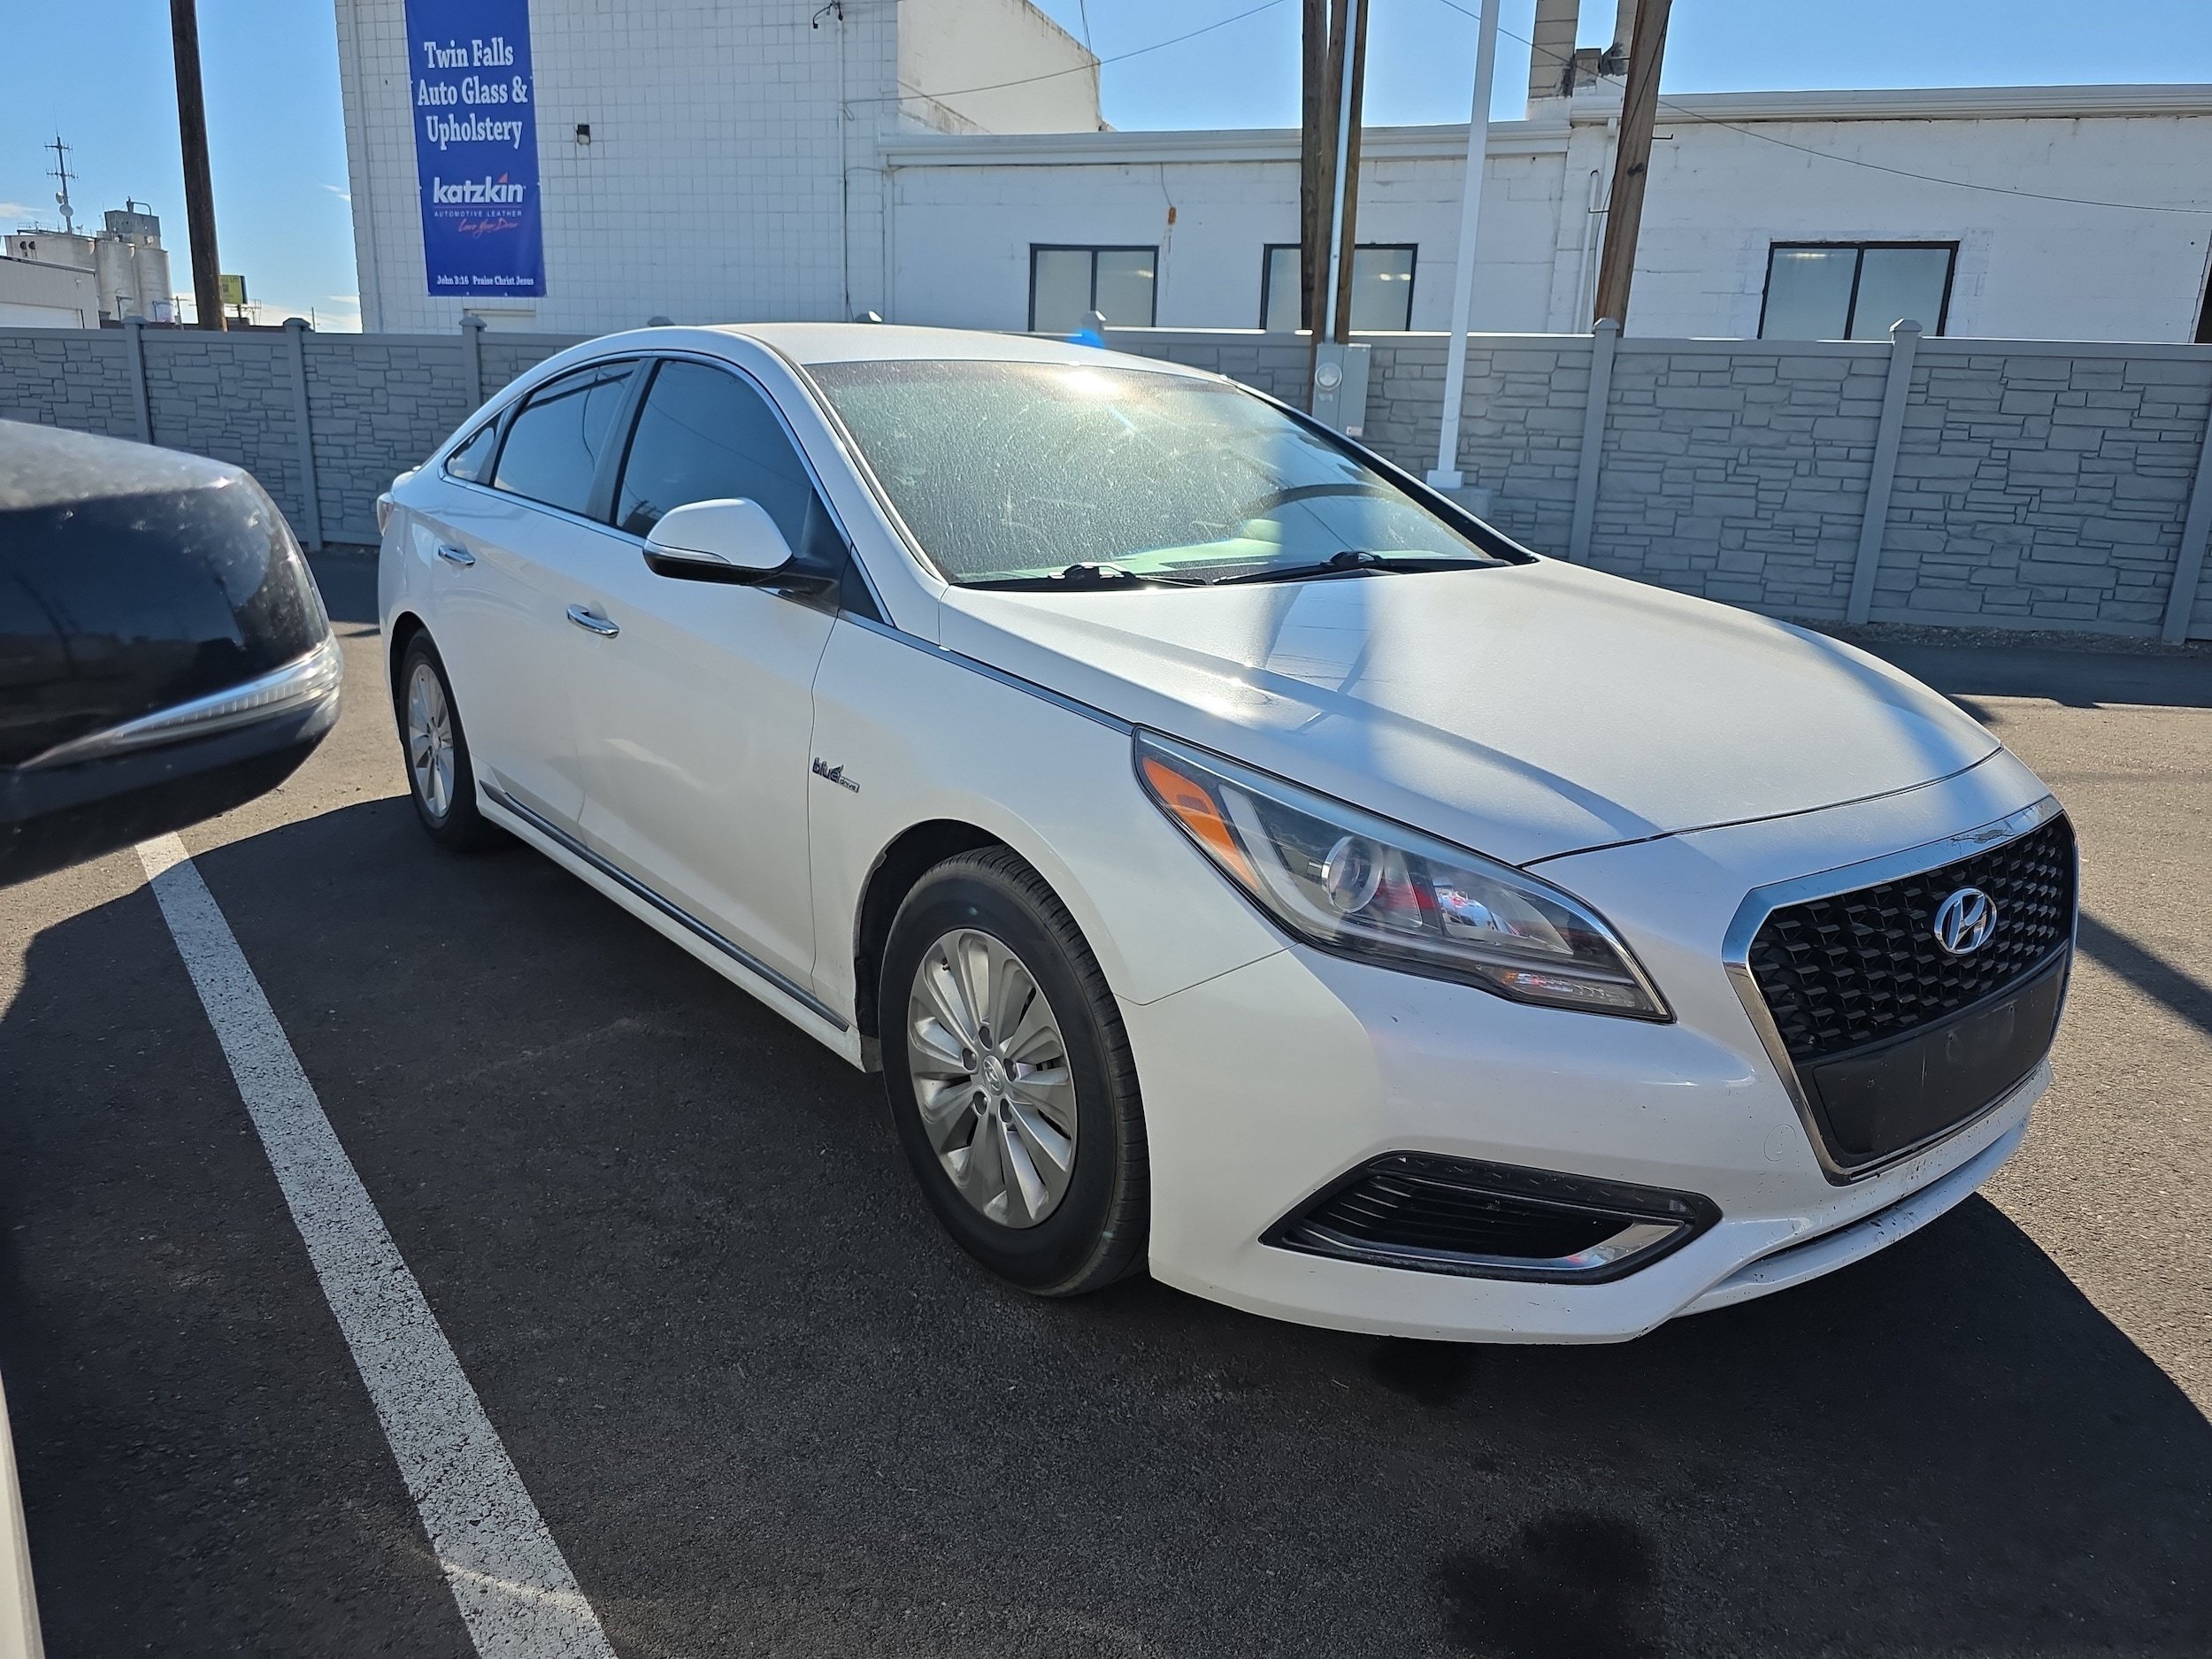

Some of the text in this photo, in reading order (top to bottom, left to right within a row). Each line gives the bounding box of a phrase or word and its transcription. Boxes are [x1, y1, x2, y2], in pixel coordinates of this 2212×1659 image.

[424, 37, 514, 68] Twin Falls
[418, 75, 528, 106] Auto Glass &
[426, 113, 523, 150] Upholstery
[434, 173, 524, 204] katzkin
[437, 274, 534, 286] John 3:16 Praise Christ Jesus
